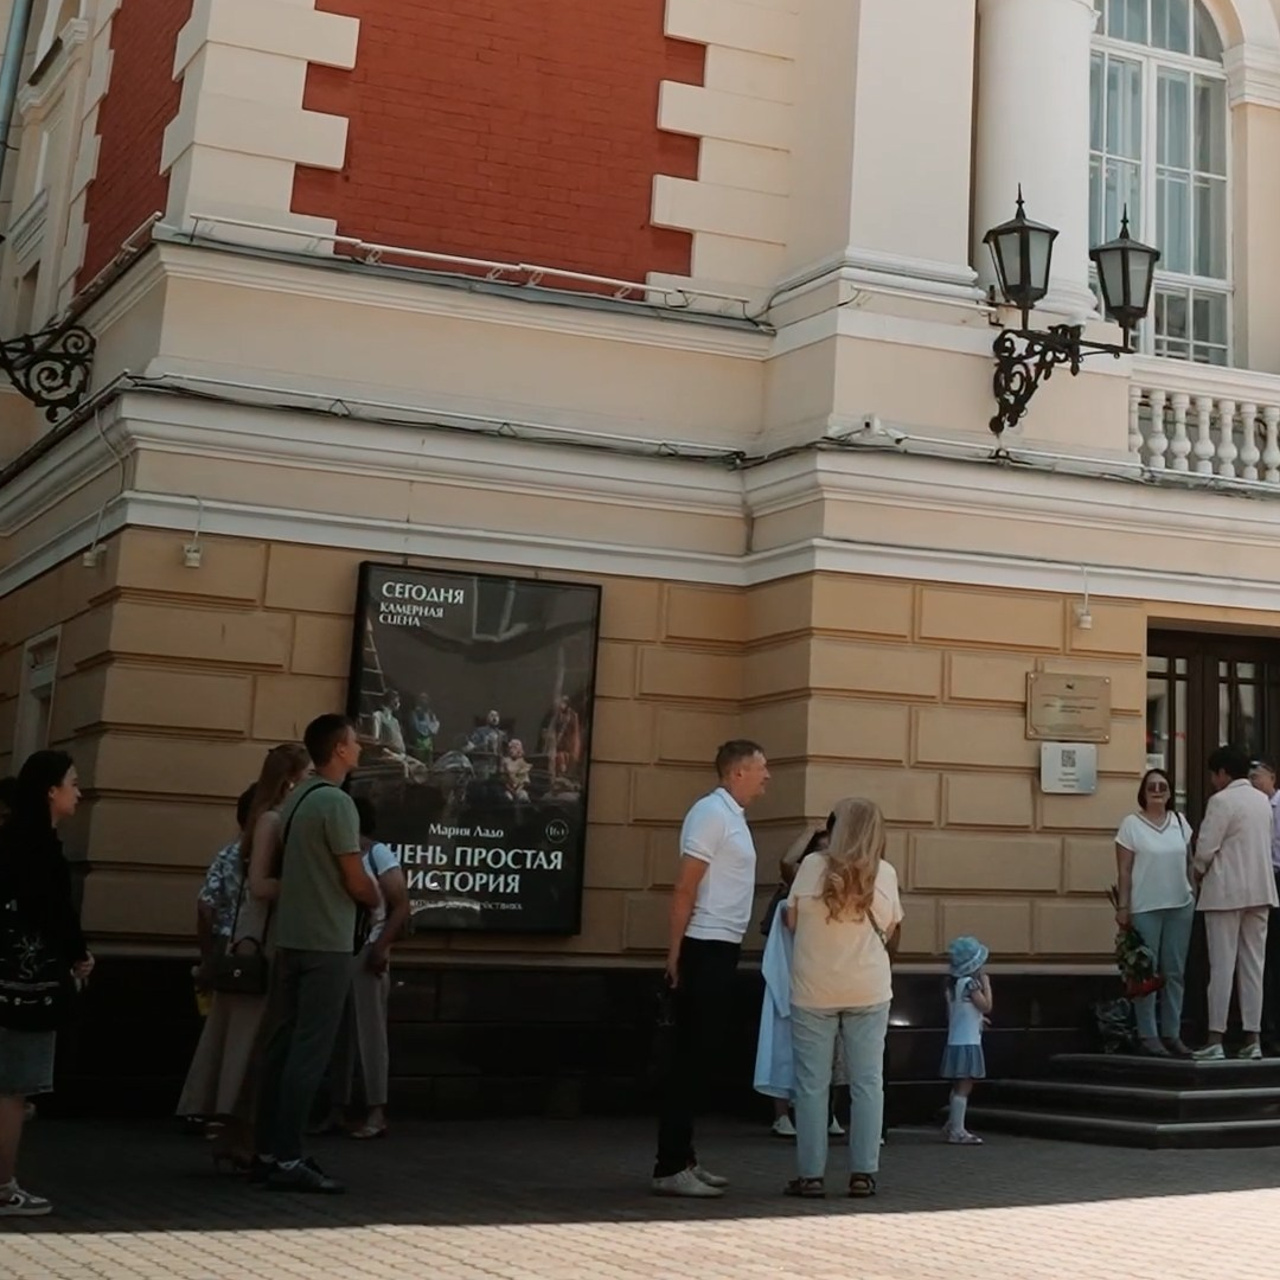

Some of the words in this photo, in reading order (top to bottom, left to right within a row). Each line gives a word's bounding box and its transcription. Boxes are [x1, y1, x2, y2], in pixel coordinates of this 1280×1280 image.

[382, 581, 465, 604] СЕГОДНЯ
[379, 601, 444, 618] КАМЕРНАЯ
[379, 613, 421, 627] СЦЕНА
[428, 822, 471, 840] Мария
[473, 825, 505, 839] Ладо
[386, 842, 448, 866] ЧЕНЬ
[454, 846, 563, 870] ПРОСТАЯ
[406, 869, 520, 894] ИСТОРИЯ
